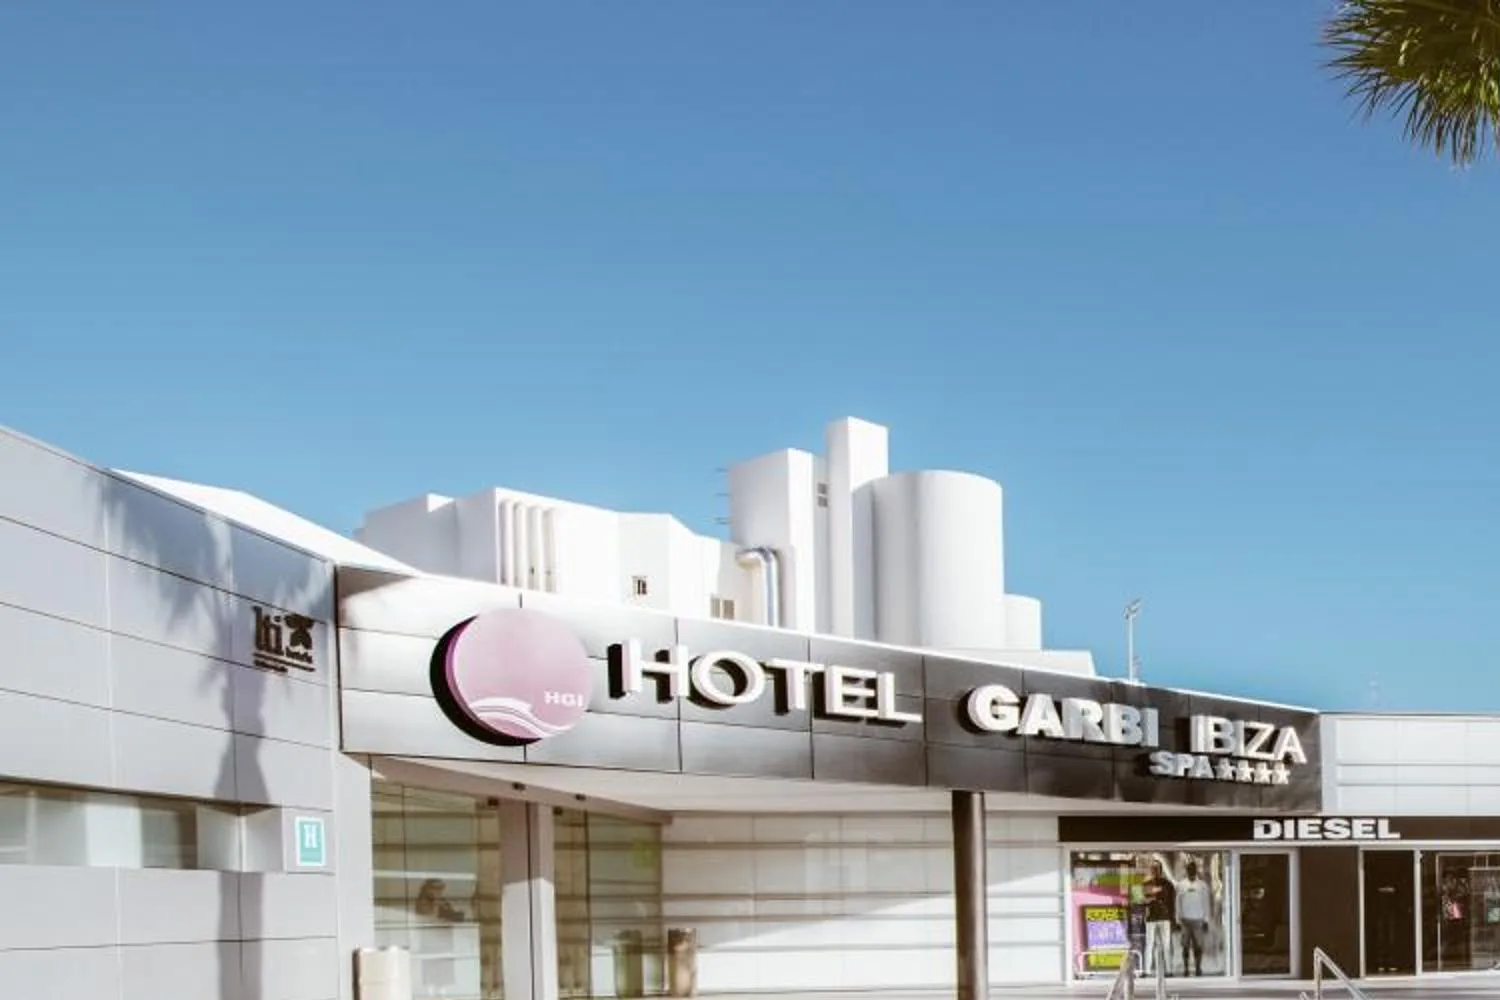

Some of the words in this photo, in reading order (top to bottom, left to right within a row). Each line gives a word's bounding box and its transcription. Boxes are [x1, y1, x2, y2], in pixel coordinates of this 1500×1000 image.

[543, 690, 583, 707] HGI
[618, 637, 923, 723] HOTEL
[967, 684, 1159, 748] GARBI
[1189, 714, 1308, 765] IBIZA
[1149, 750, 1215, 780] SPA
[303, 823, 318, 849] H
[1253, 818, 1401, 840] DIESEL
